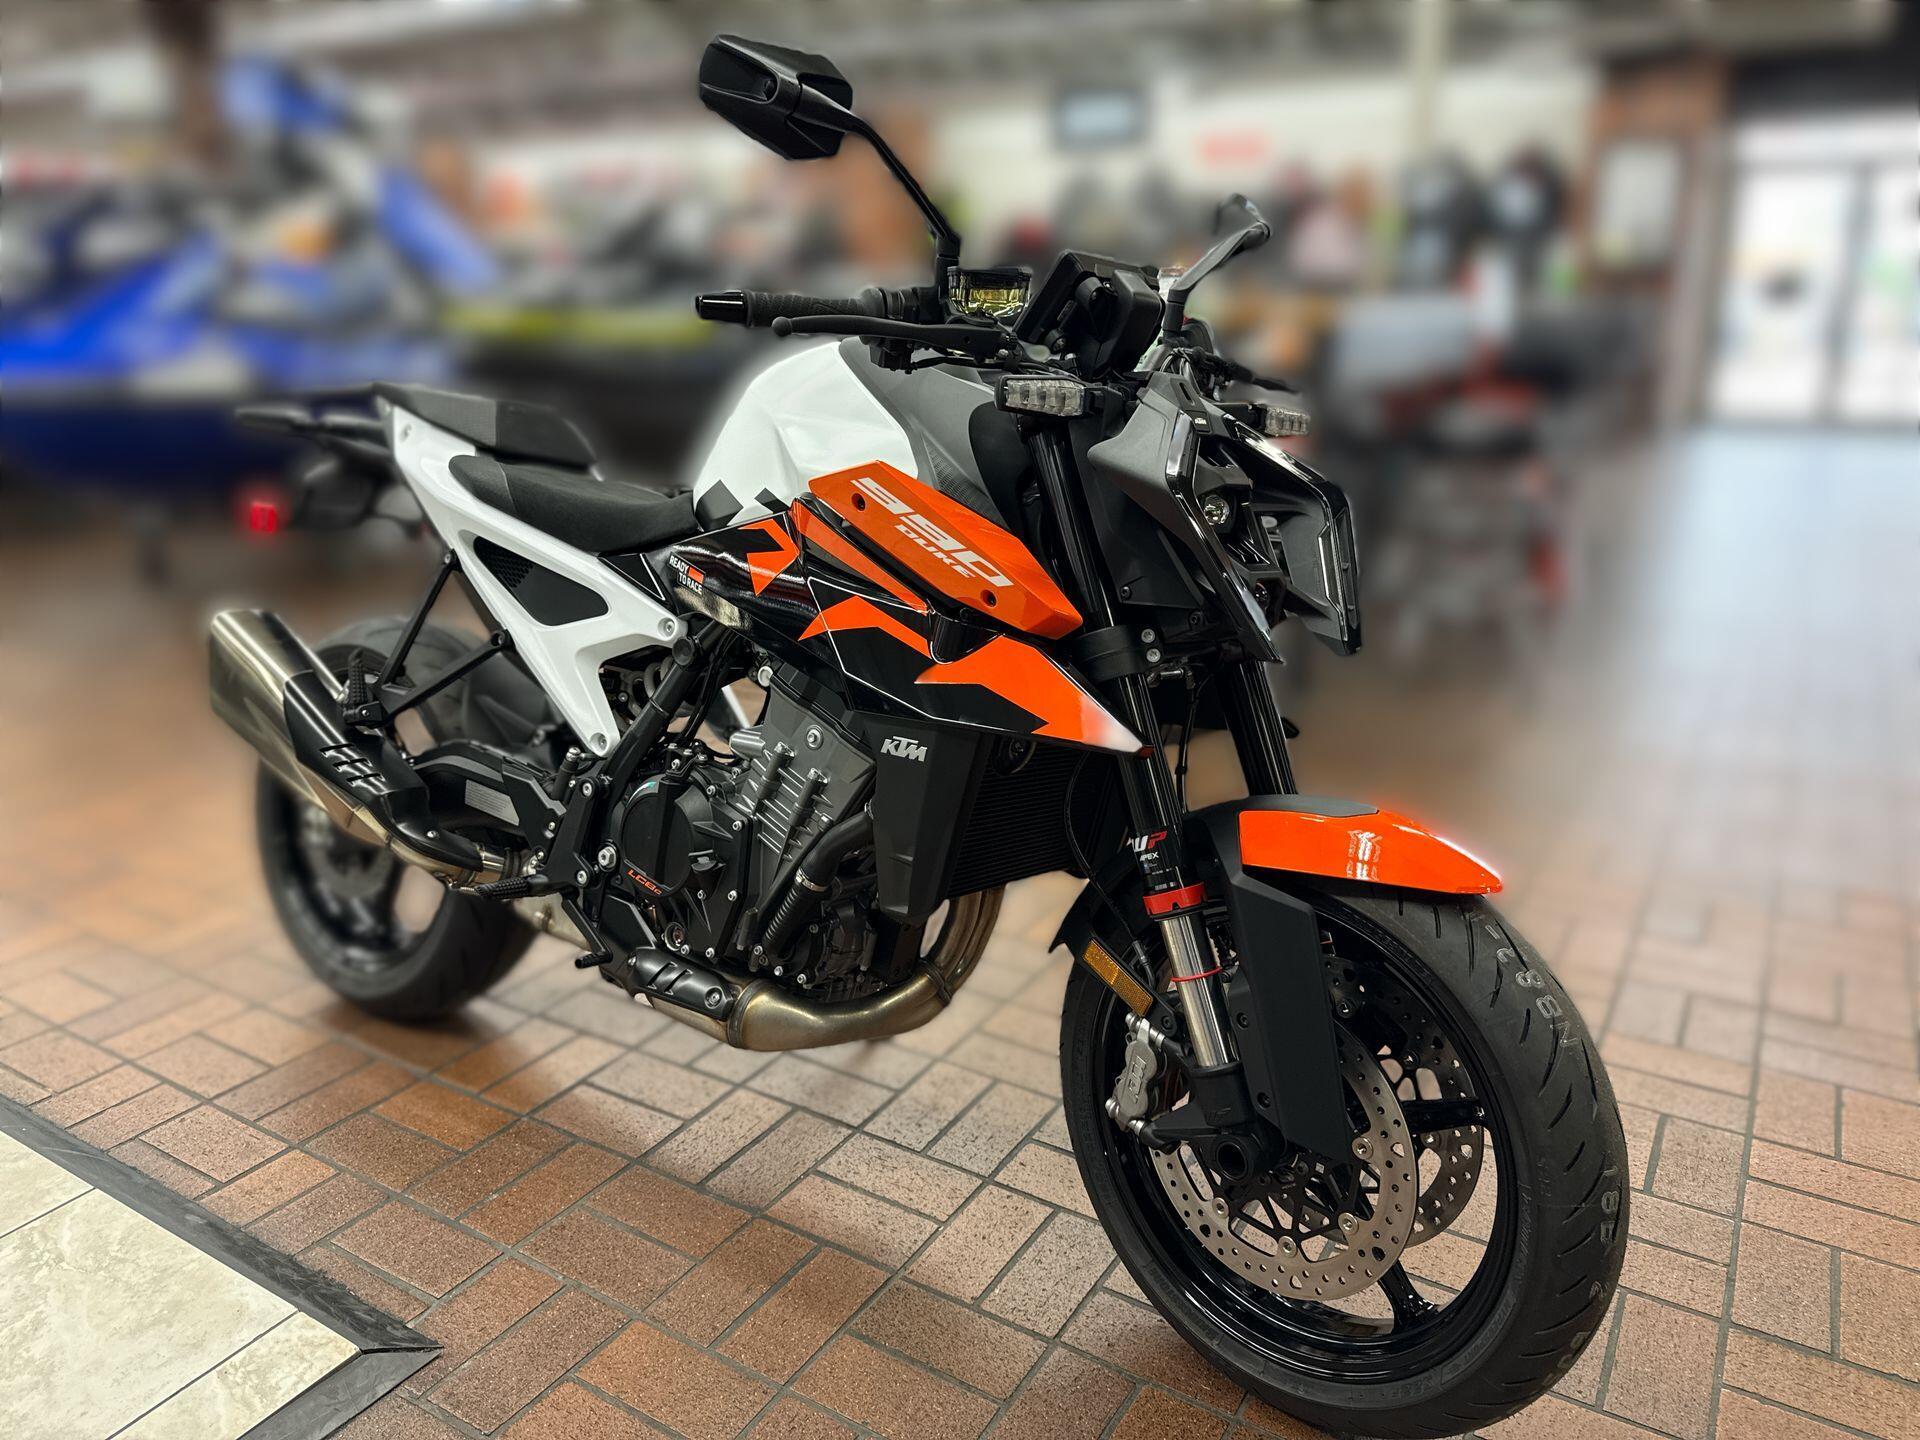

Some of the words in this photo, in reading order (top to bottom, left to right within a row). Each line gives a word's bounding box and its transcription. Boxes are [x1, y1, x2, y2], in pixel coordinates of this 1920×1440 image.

[850, 477, 1015, 588] 990
[669, 555, 690, 574] READY
[894, 524, 976, 578] DUKE
[679, 571, 687, 585] TO
[686, 577, 703, 596] RACE
[880, 735, 928, 762] KTM
